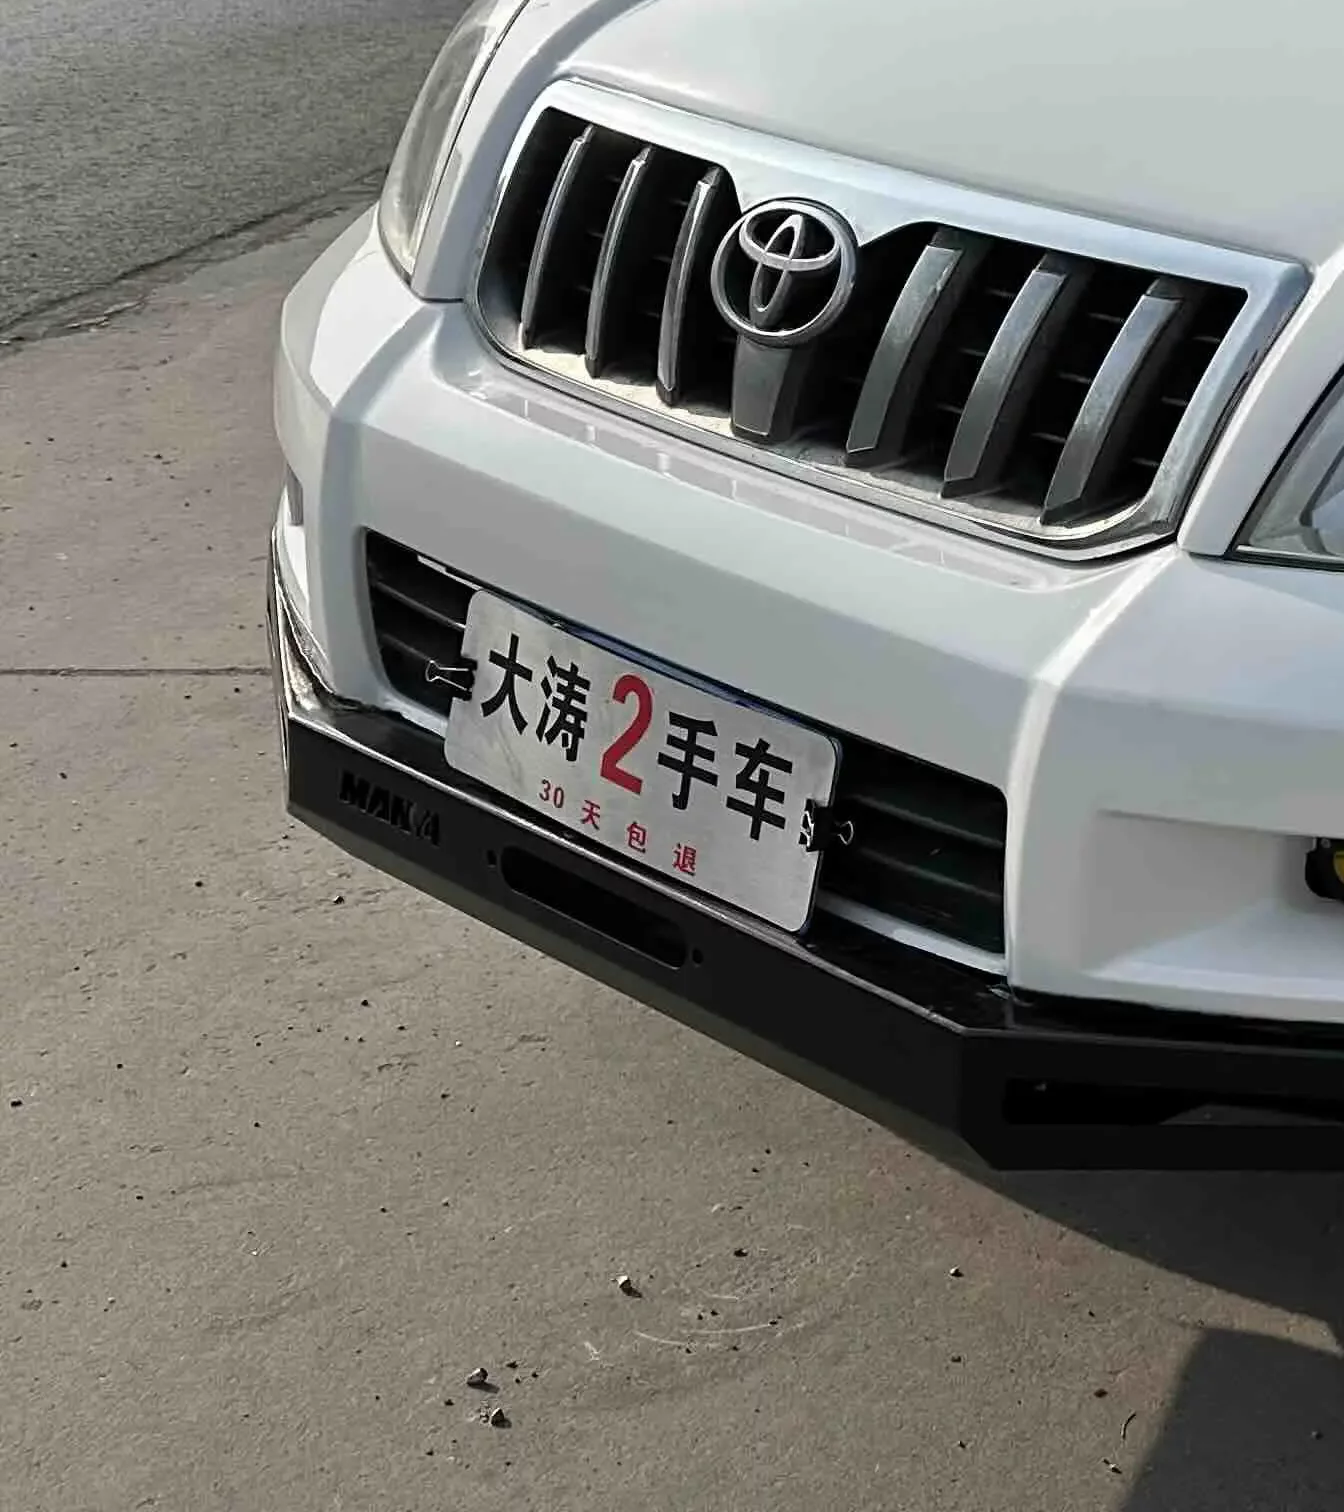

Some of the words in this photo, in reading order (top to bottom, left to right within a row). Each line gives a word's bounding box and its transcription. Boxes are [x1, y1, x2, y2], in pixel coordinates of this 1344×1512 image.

[480, 633, 793, 841] 大涛2手车
[538, 778, 698, 877] 30天包退
